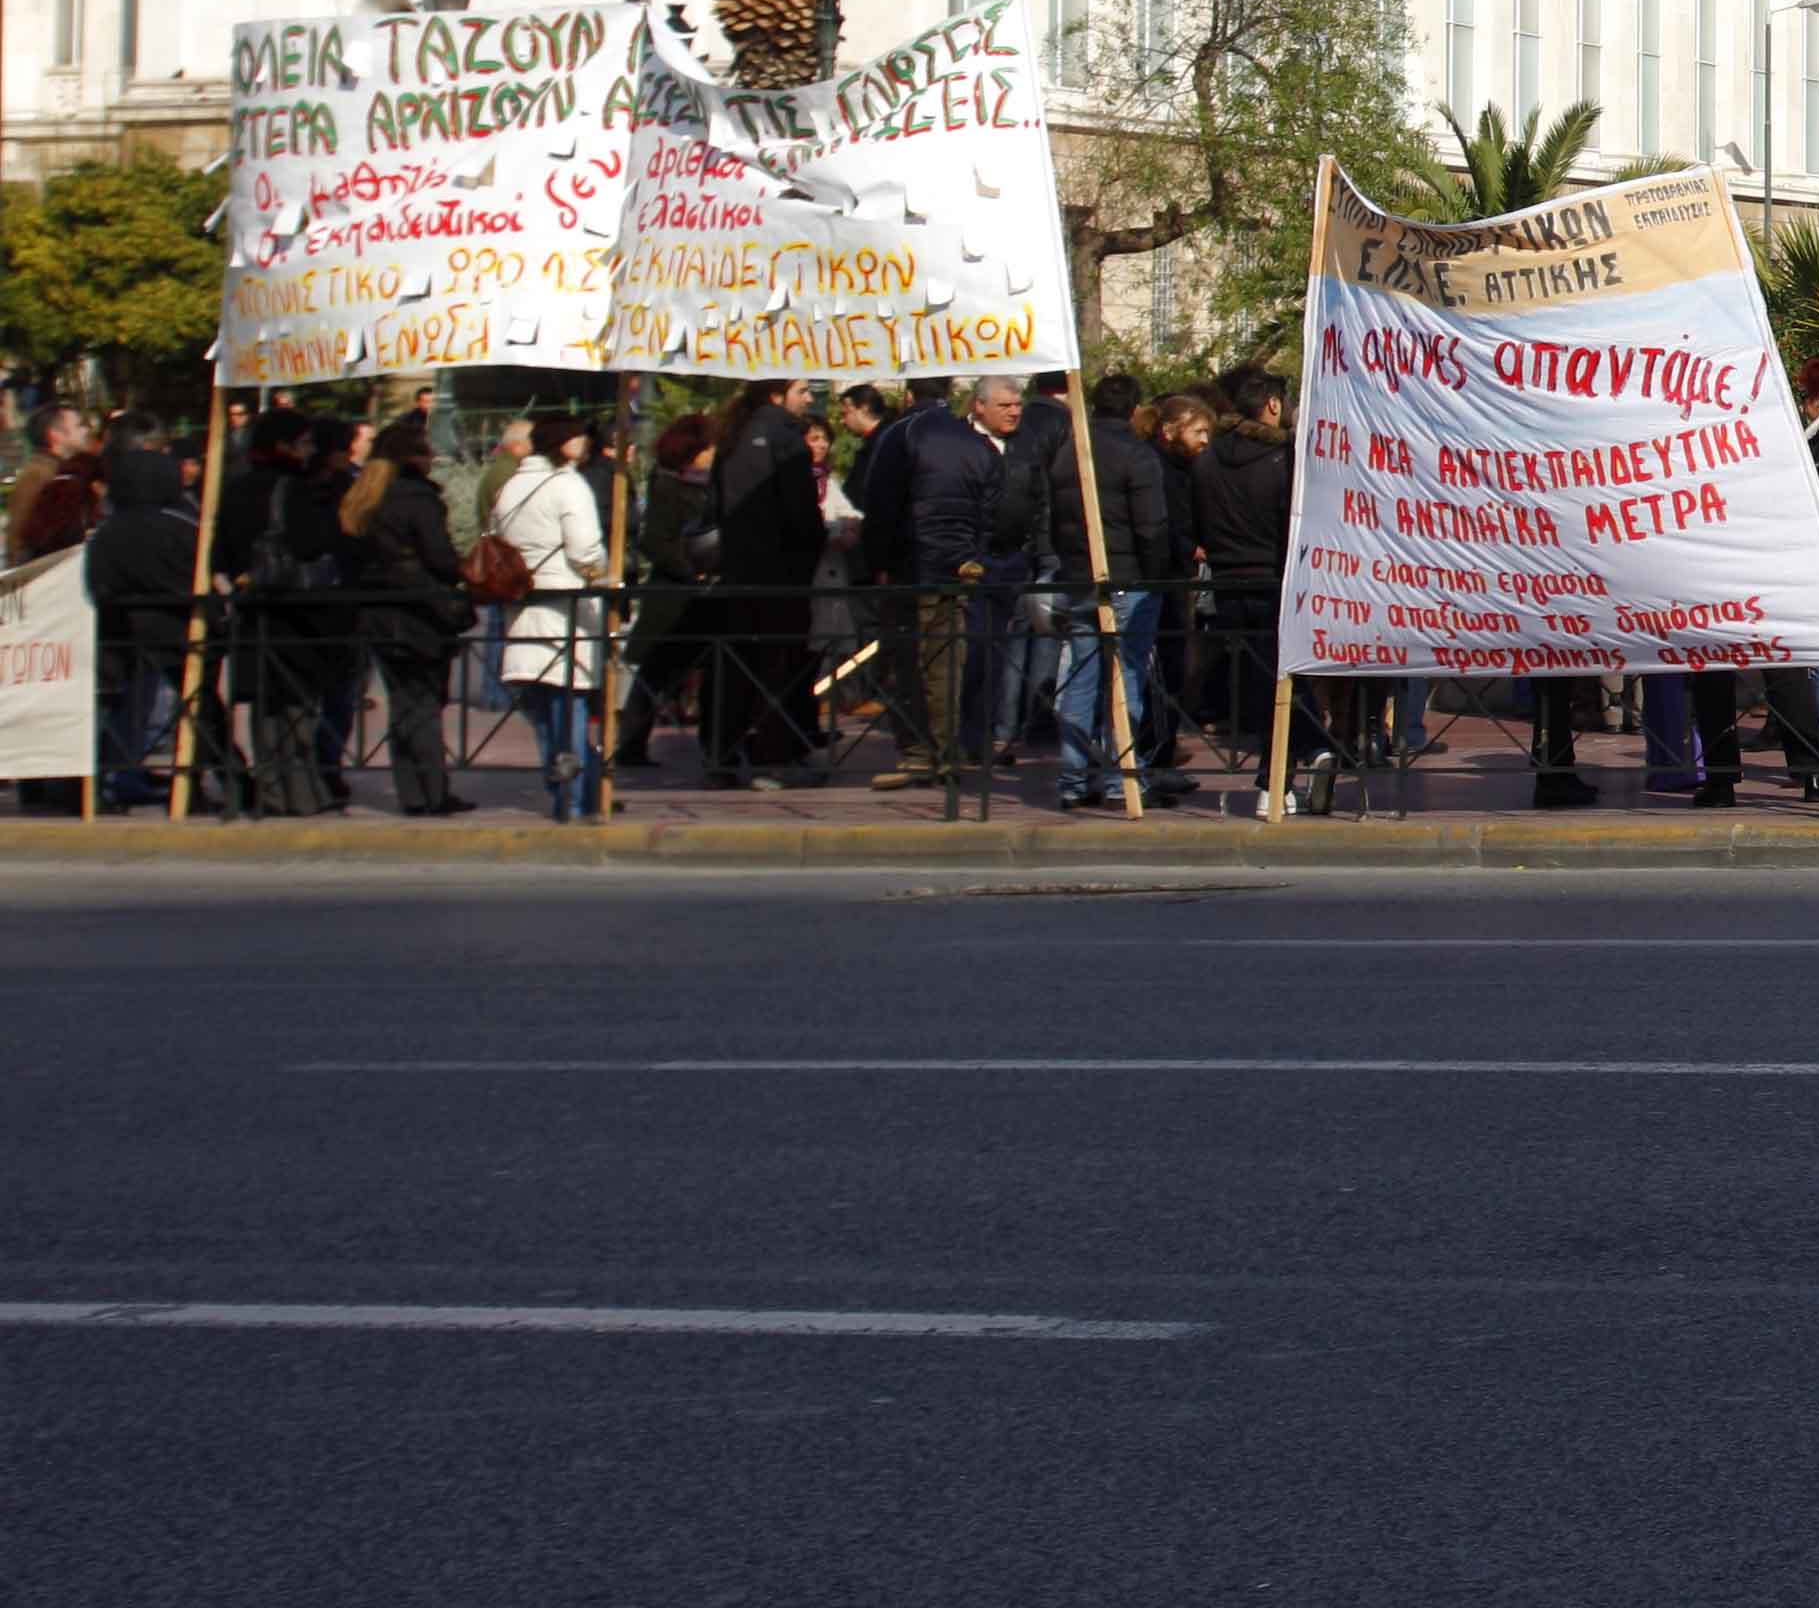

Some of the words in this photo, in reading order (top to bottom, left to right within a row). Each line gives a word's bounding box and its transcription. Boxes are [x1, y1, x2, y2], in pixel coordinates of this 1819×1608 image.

[374, 11, 604, 83] ΤΑΖΟΥΝ
[366, 76, 577, 153] ΑΡΧΙΖΟΥΝ
[1483, 252, 1623, 303] ΑΤΤΙΚΗΣ
[1321, 323, 1349, 378] Με
[1315, 419, 1351, 465] ΣΤΑ
[1368, 432, 1413, 478] ΝΕΑ
[1438, 419, 1761, 492] ΑΝΤΙΕΚΠΑΙΔΕΥΤΙΚΑ
[1343, 487, 1379, 528] ΚΑΙ
[1586, 482, 1727, 545] ΜΕΤΡΑ
[1311, 546, 1360, 577] στην
[1311, 594, 1371, 625] στην
[1542, 614, 1590, 636] της
[1614, 595, 1767, 640] δημόσιας
